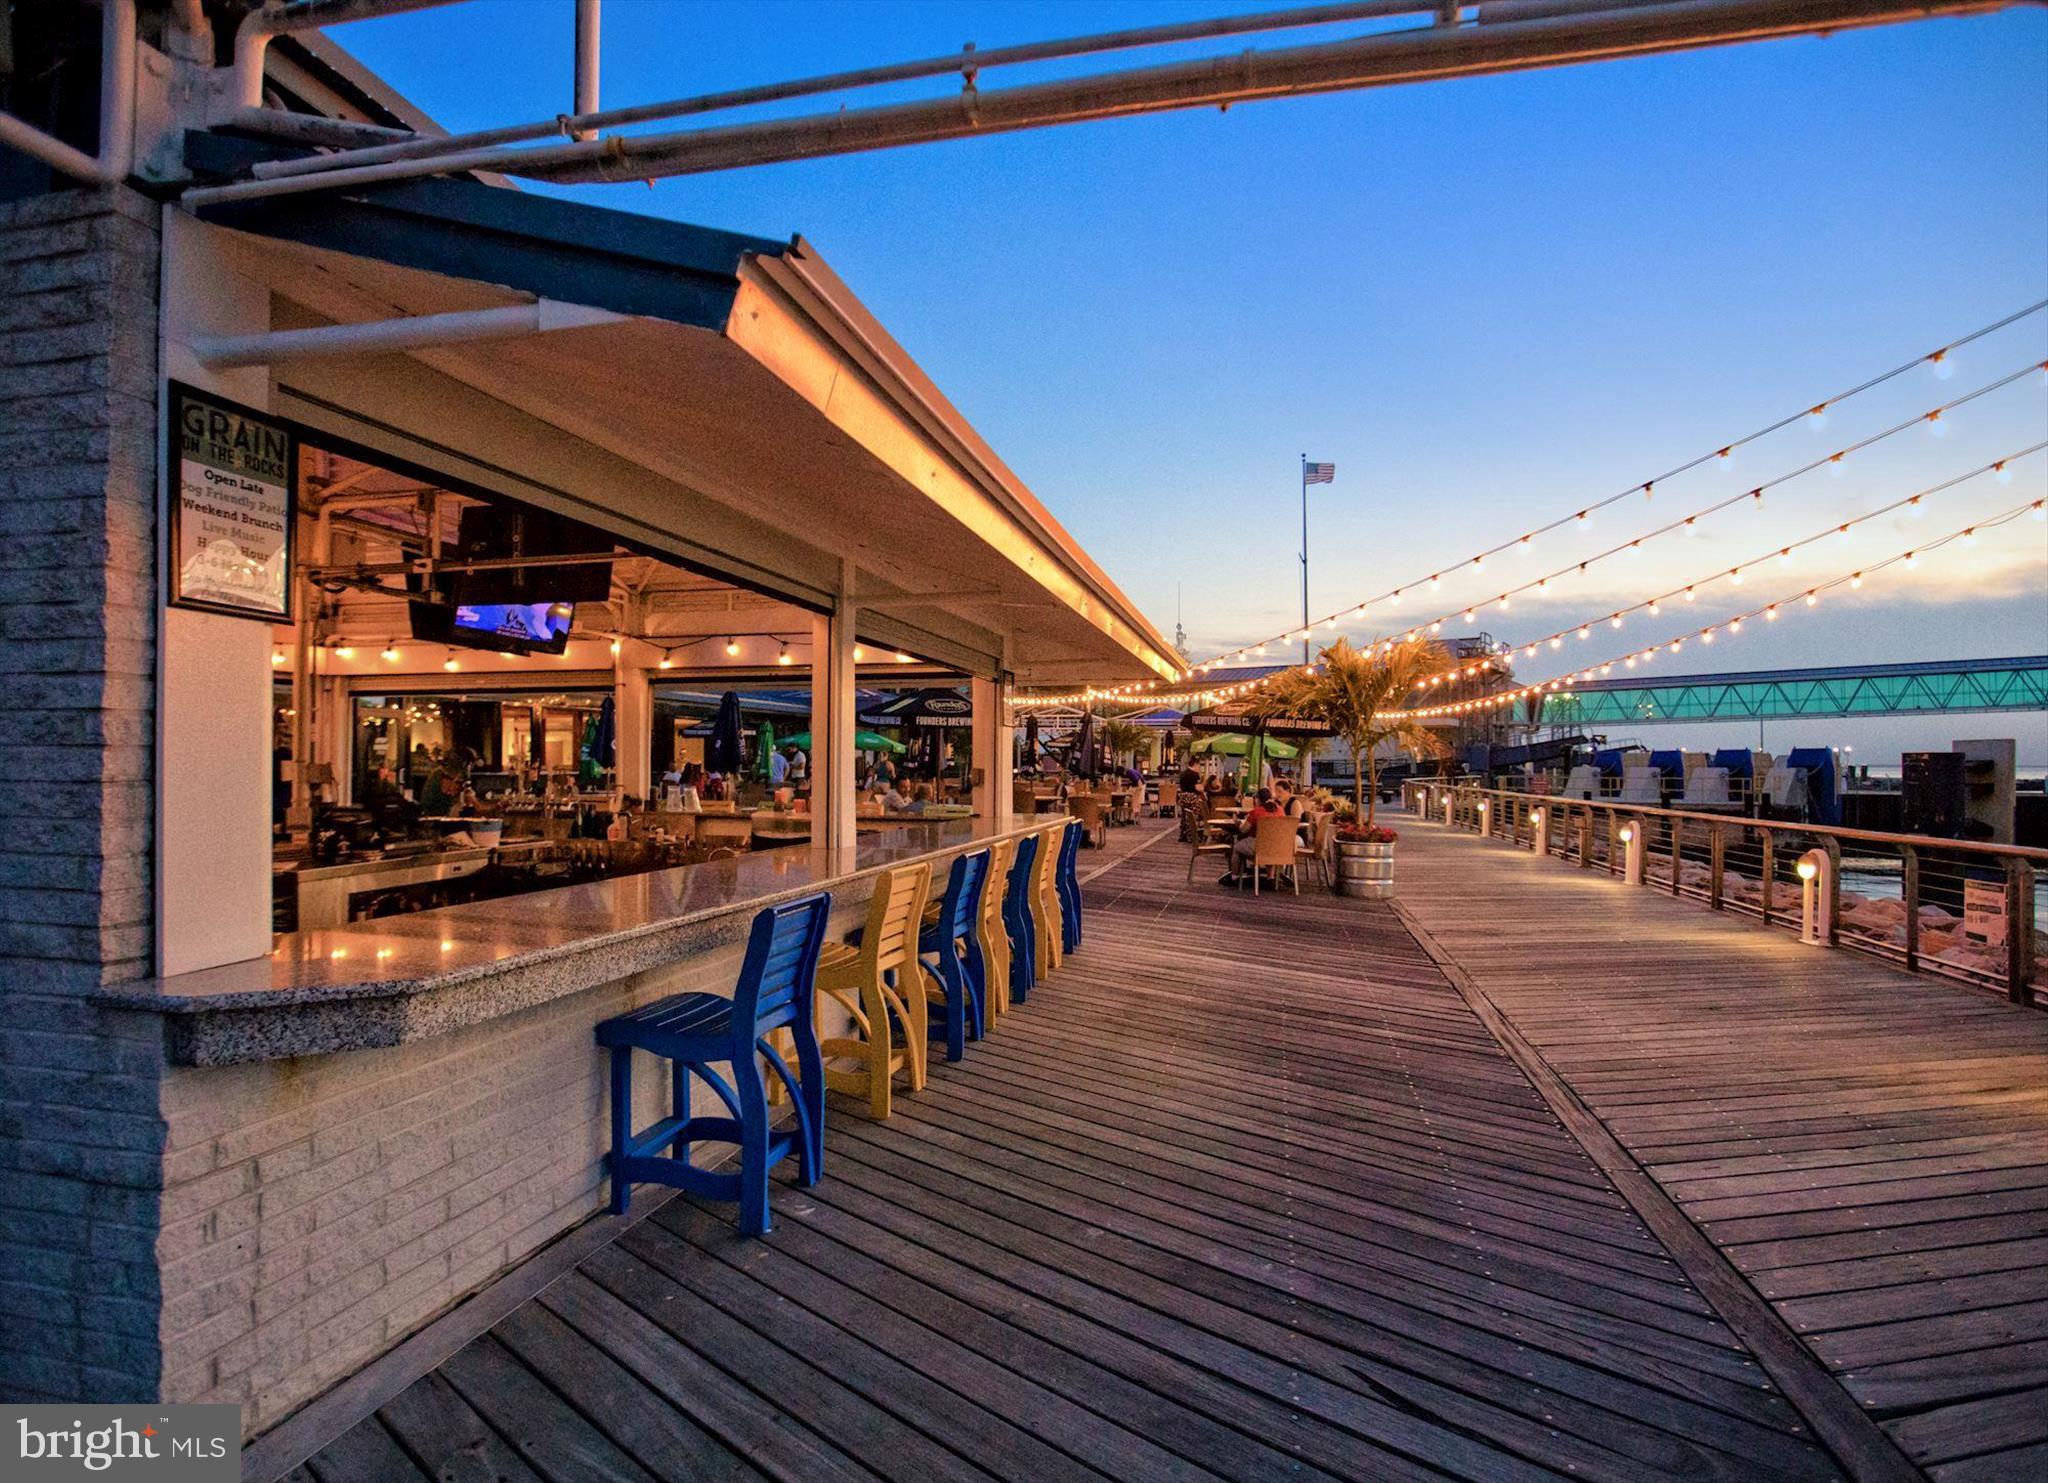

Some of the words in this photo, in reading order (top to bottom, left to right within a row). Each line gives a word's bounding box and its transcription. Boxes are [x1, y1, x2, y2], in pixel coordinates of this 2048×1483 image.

[183, 404, 285, 462] GRAIN
[182, 434, 200, 453] ON
[208, 442, 235, 465] THE
[244, 453, 285, 479] ROCKS
[204, 469, 237, 487] Open
[240, 479, 264, 495] Late
[206, 486, 256, 511] Friendly
[258, 501, 287, 516] Patio
[182, 498, 238, 521] Weekend
[241, 512, 283, 532] Brunch
[202, 520, 228, 536] Live
[231, 527, 266, 545] Music
[240, 546, 270, 561] Hour
[916, 716, 947, 726] FOUNDERS
[948, 716, 973, 727] BREWIN
[1192, 715, 1217, 725] FOUNDERS
[1218, 716, 1241, 726] BREWING
[1266, 718, 1295, 729] FOUNDERS
[1296, 719, 1322, 730] BREWING
